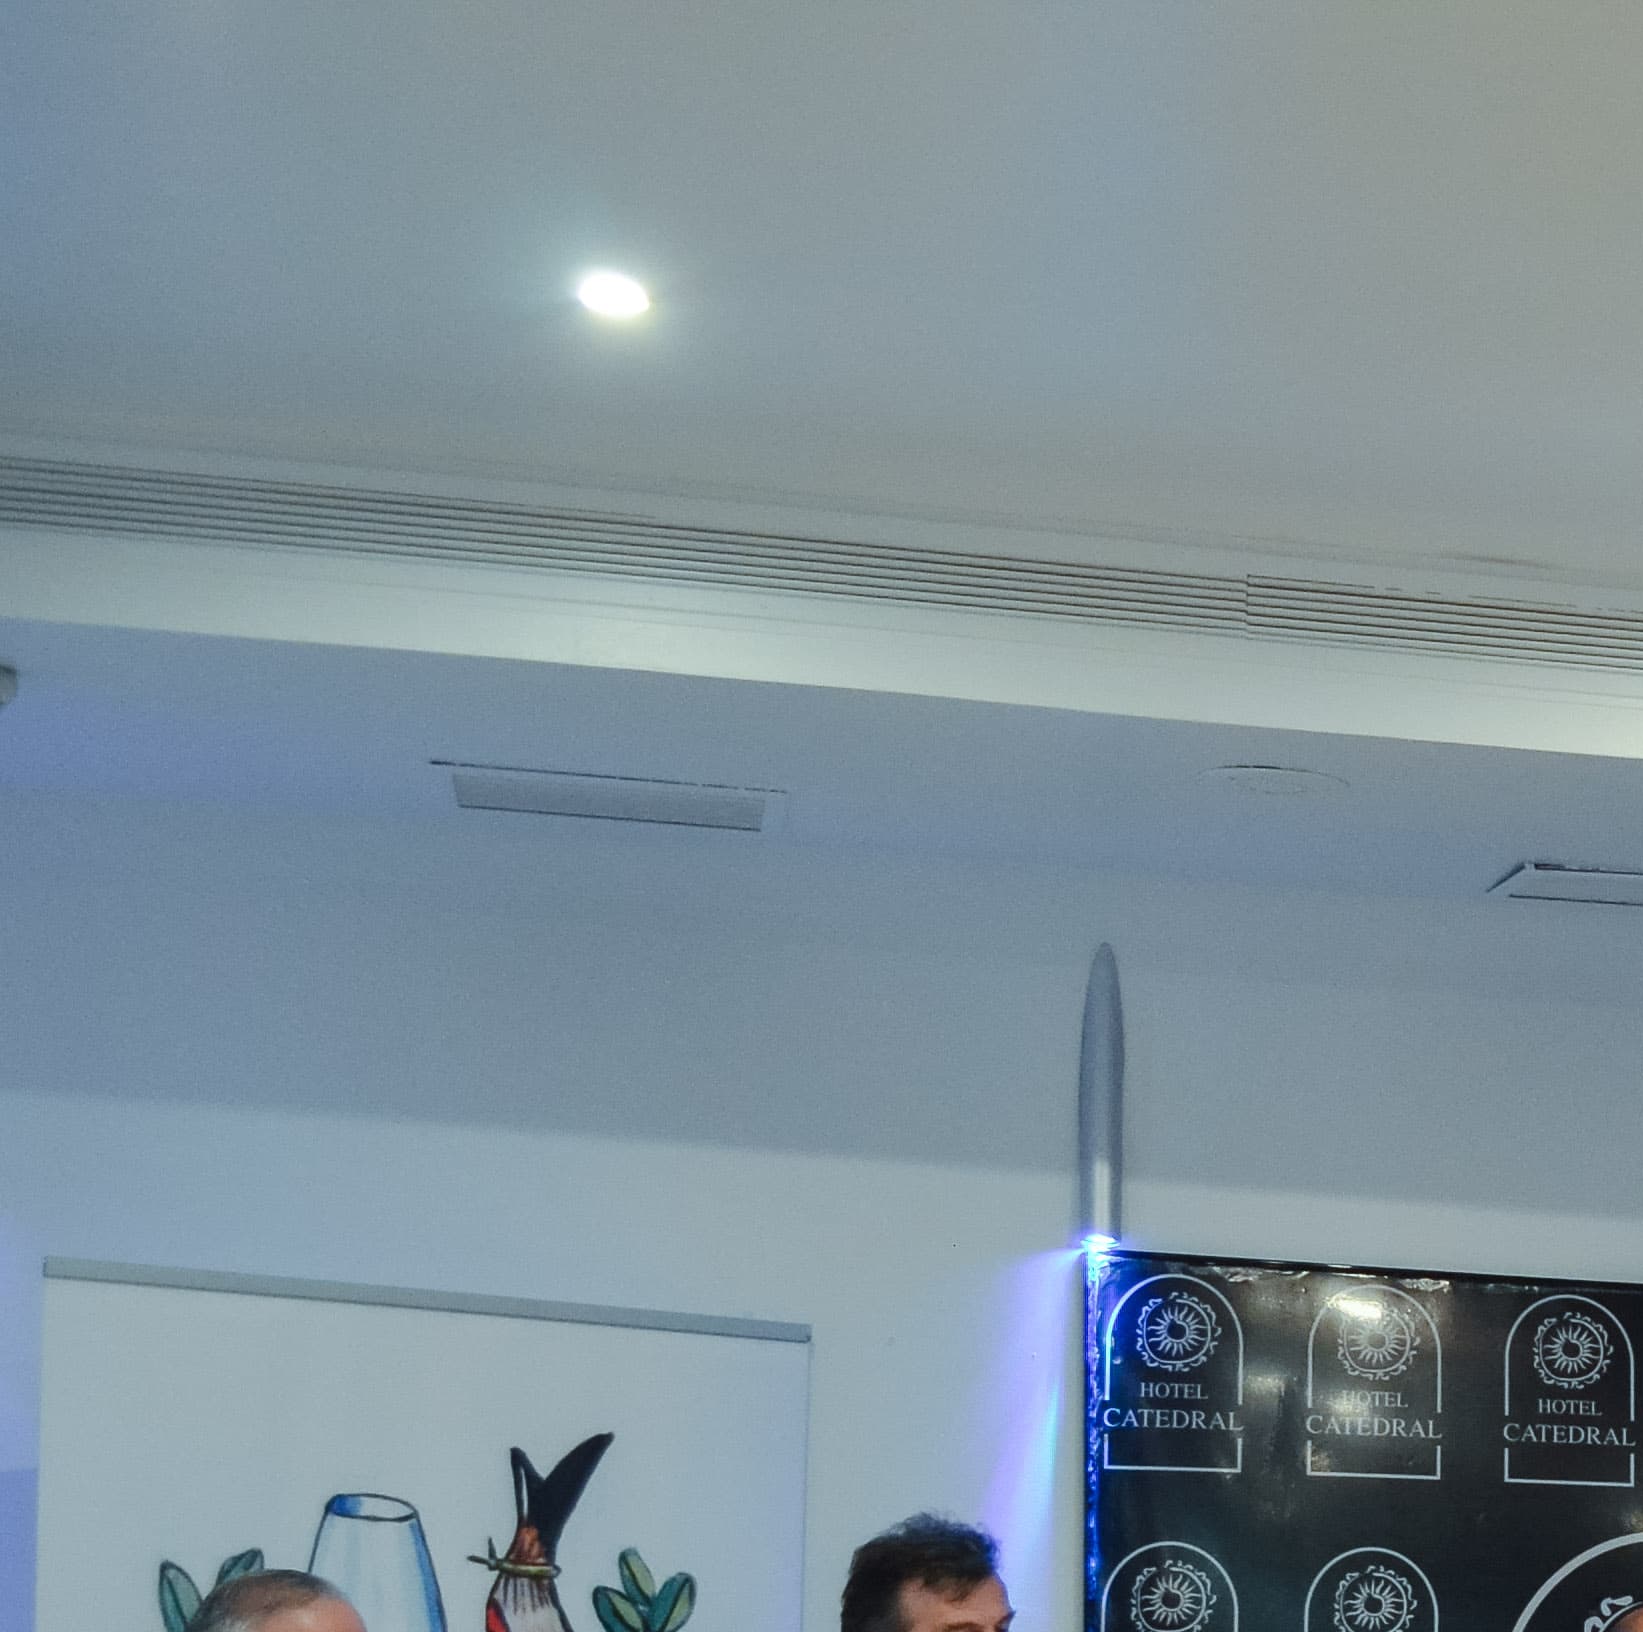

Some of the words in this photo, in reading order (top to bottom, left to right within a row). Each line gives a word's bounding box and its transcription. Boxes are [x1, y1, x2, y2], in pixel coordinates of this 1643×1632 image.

[1140, 1382, 1208, 1400] HOTEL
[1341, 1390, 1409, 1408] HOTEL
[1538, 1399, 1603, 1416] HOTEL
[1103, 1407, 1244, 1432] CATEDRAL
[1306, 1414, 1443, 1440] CATEDRAL
[1503, 1423, 1636, 1447] CATEDRAL
